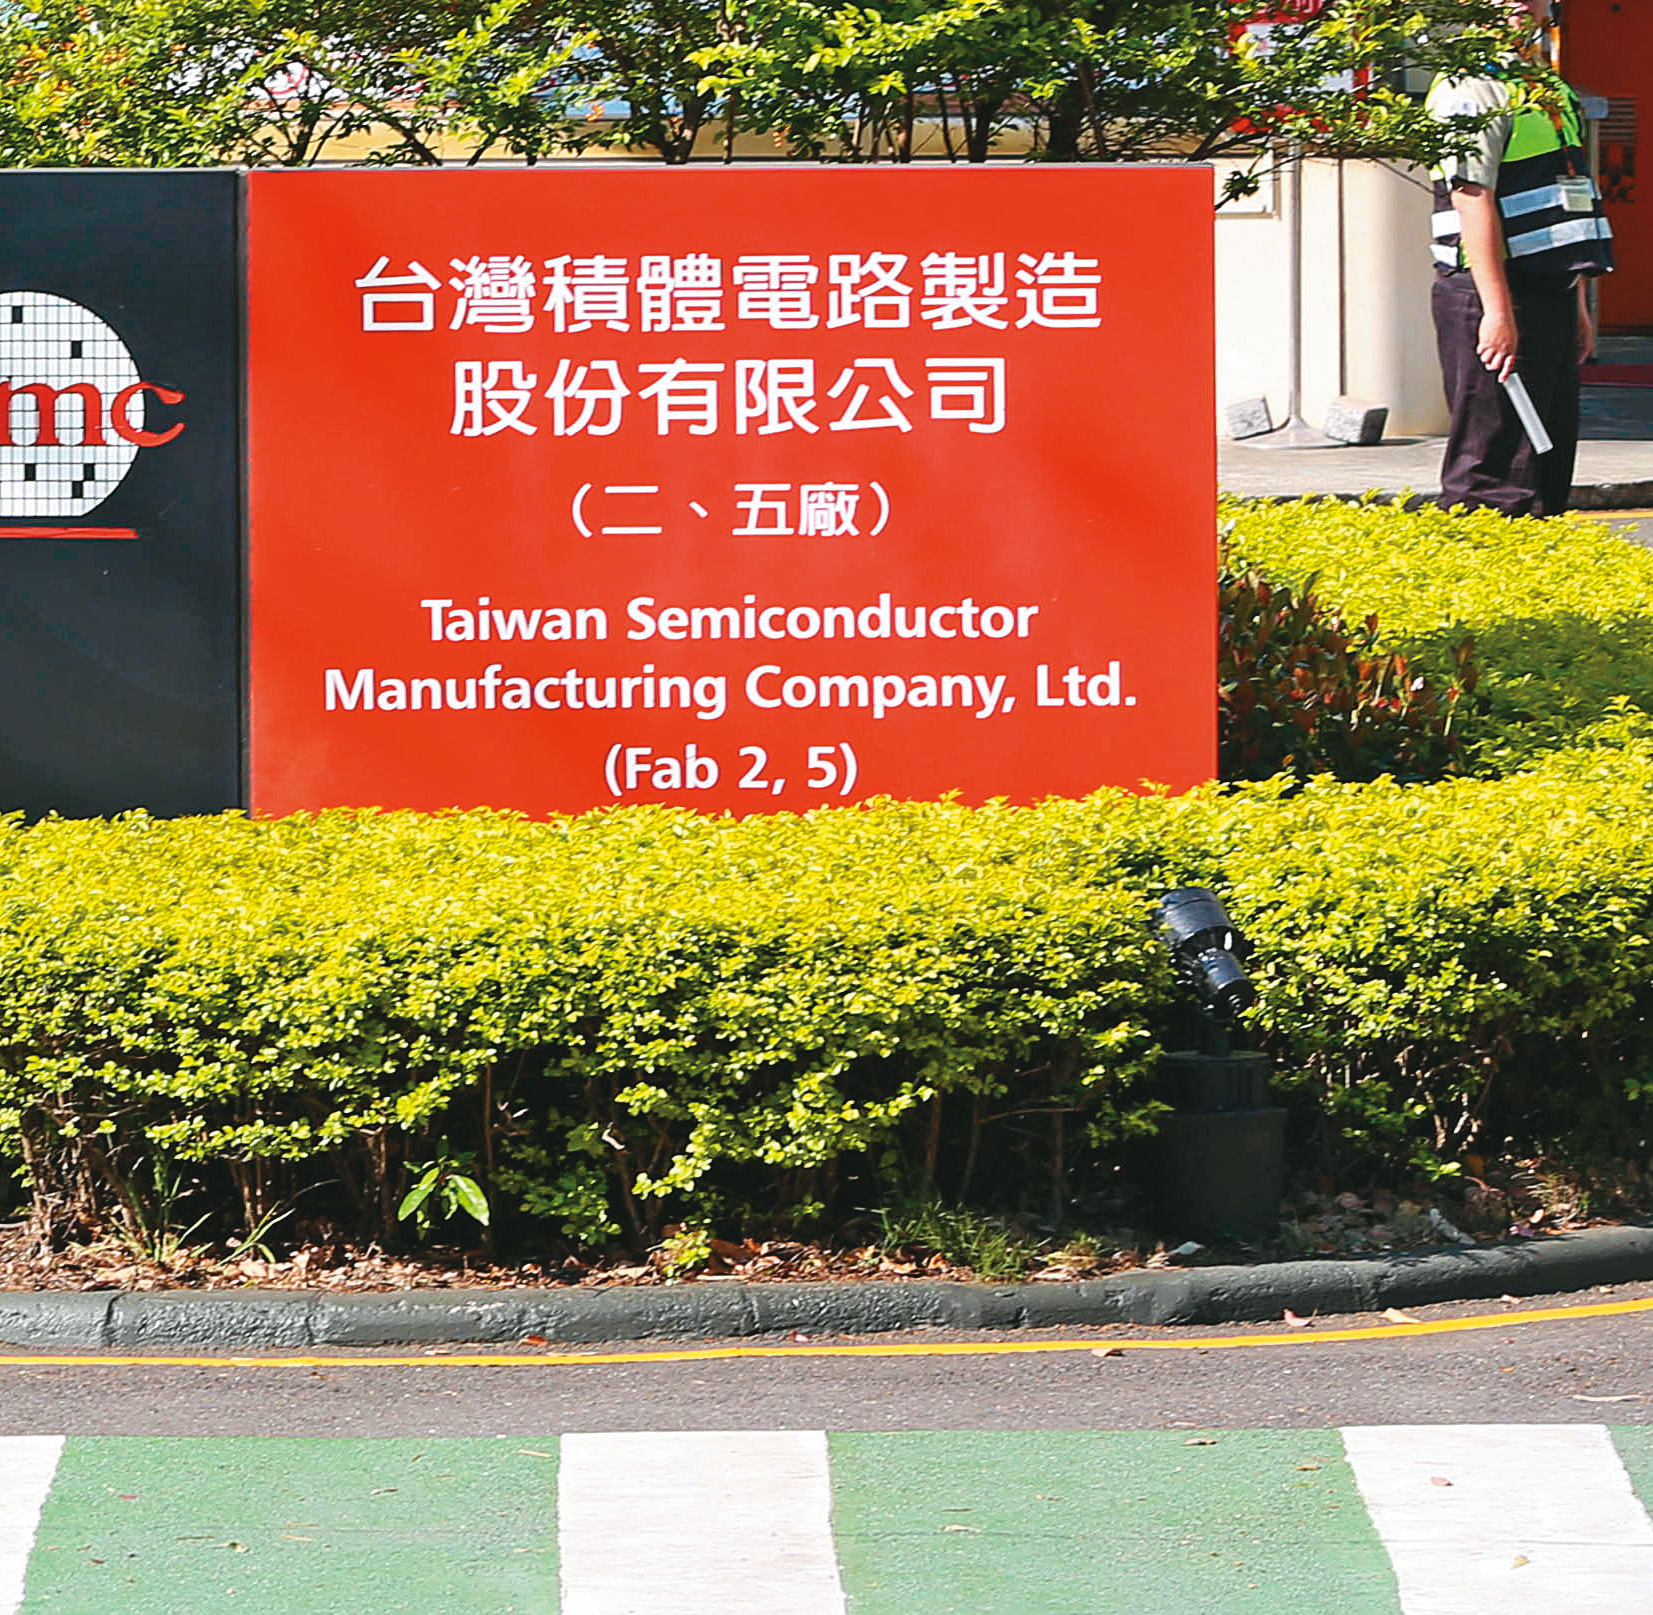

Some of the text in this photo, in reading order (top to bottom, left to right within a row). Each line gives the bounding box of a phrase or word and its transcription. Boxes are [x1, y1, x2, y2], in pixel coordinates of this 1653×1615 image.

[354, 250, 1103, 333] 台灣積體電路製造
[449, 356, 1007, 437] 股份有限公司
[420, 592, 1040, 642] Taiwan Semiconductor
[324, 660, 1138, 720] Manufacturing Company, Ltd.
[604, 742, 859, 797] (Fab 2, 5)
